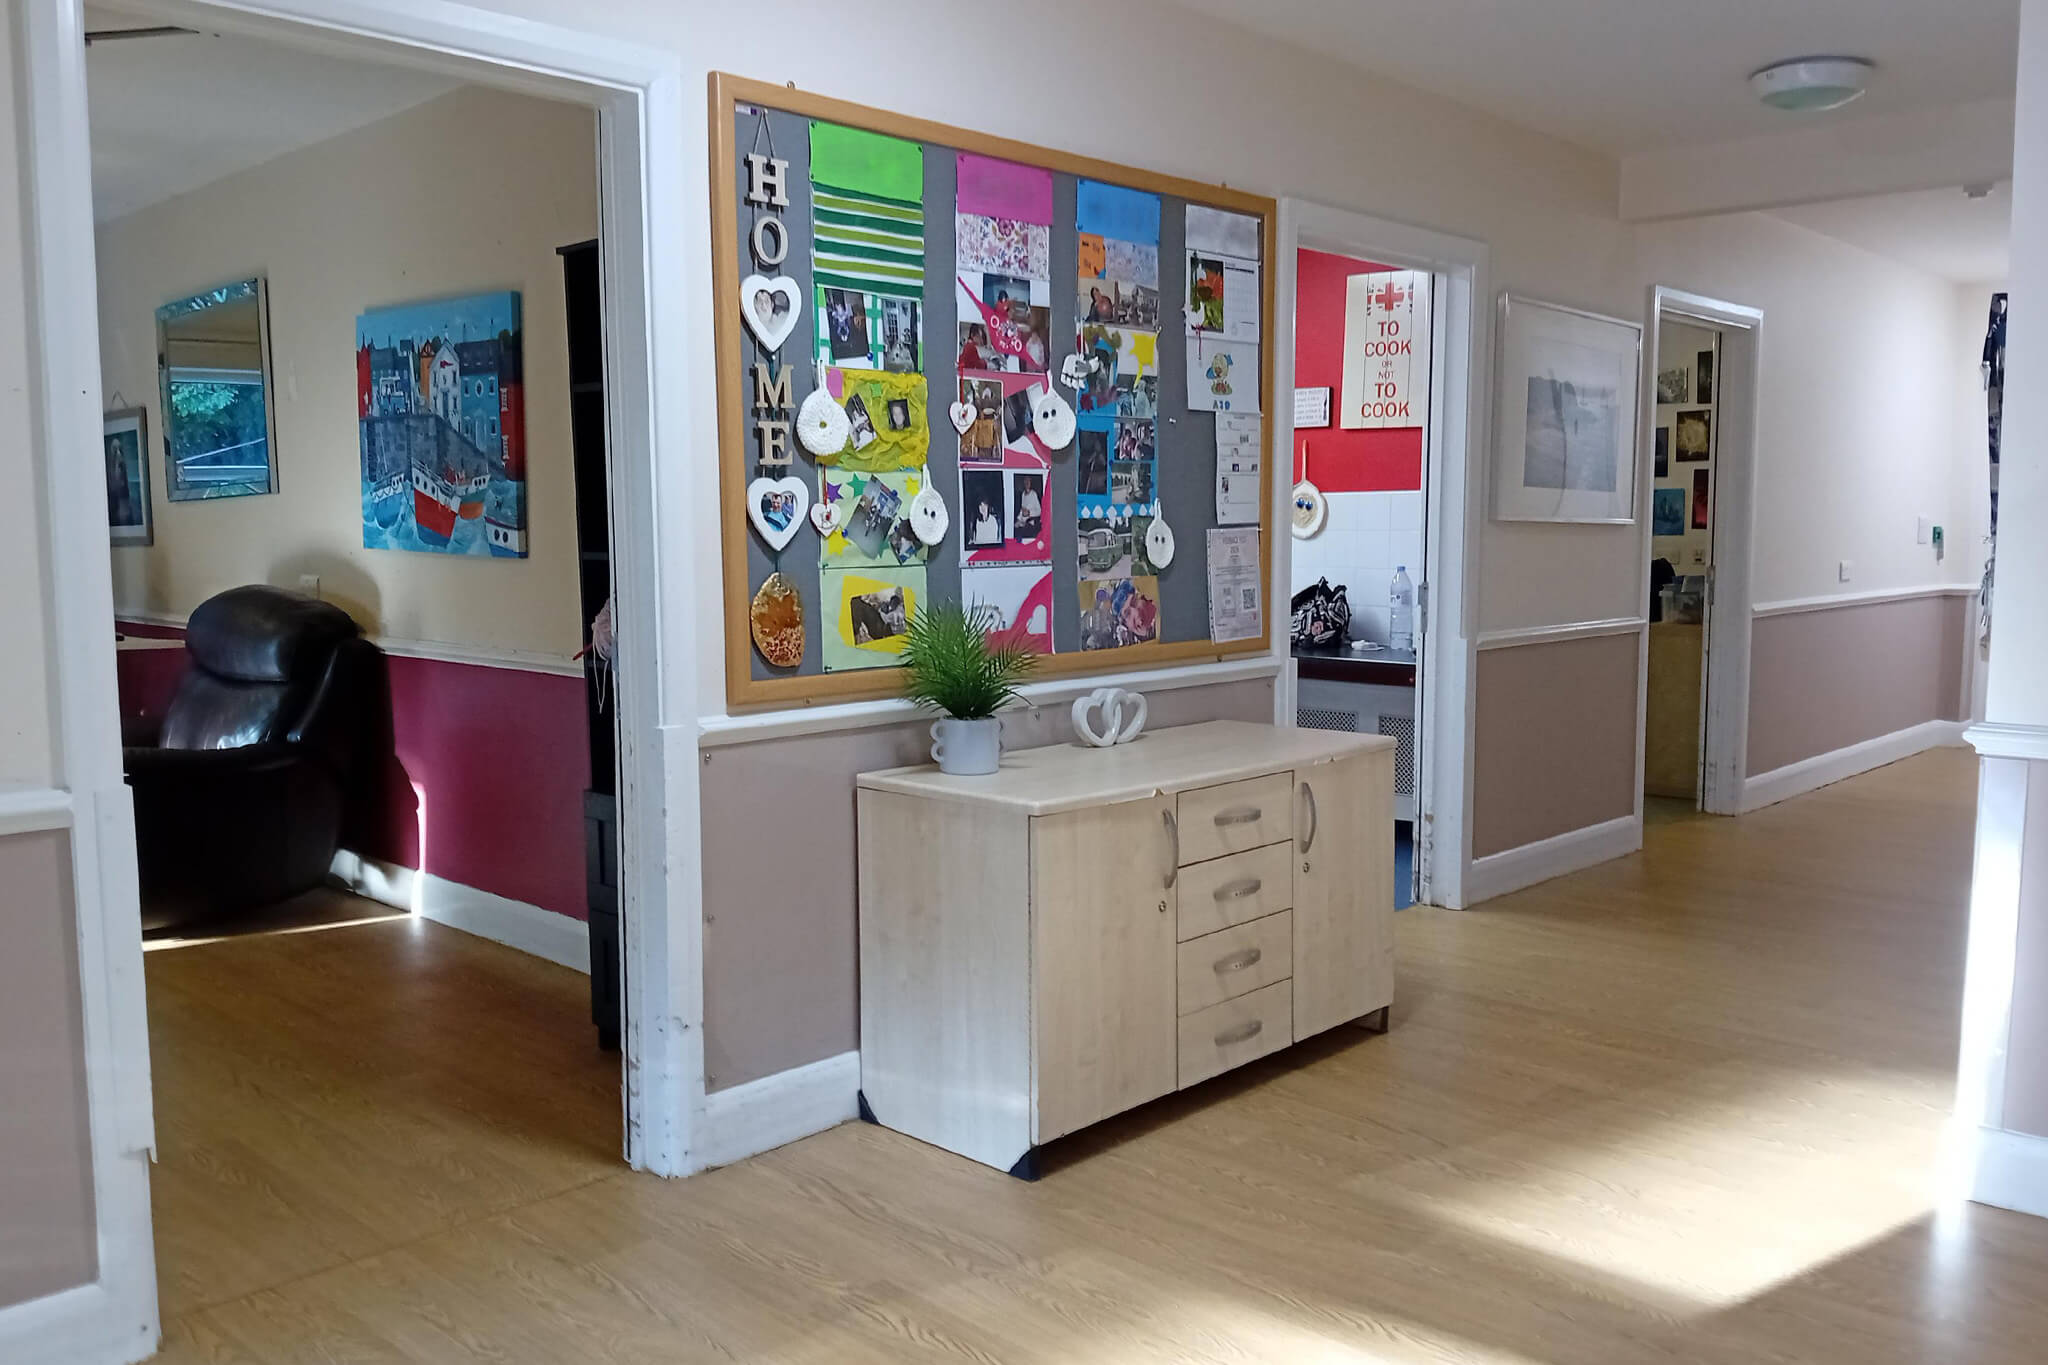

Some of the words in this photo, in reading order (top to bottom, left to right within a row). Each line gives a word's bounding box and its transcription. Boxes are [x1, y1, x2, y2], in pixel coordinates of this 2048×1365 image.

[1377, 320, 1400, 337] TO
[1364, 339, 1412, 357] COOK
[1381, 360, 1393, 369] OR
[1378, 371, 1394, 380] NOT
[1375, 382, 1397, 399] TO
[1361, 401, 1410, 418] COOK
